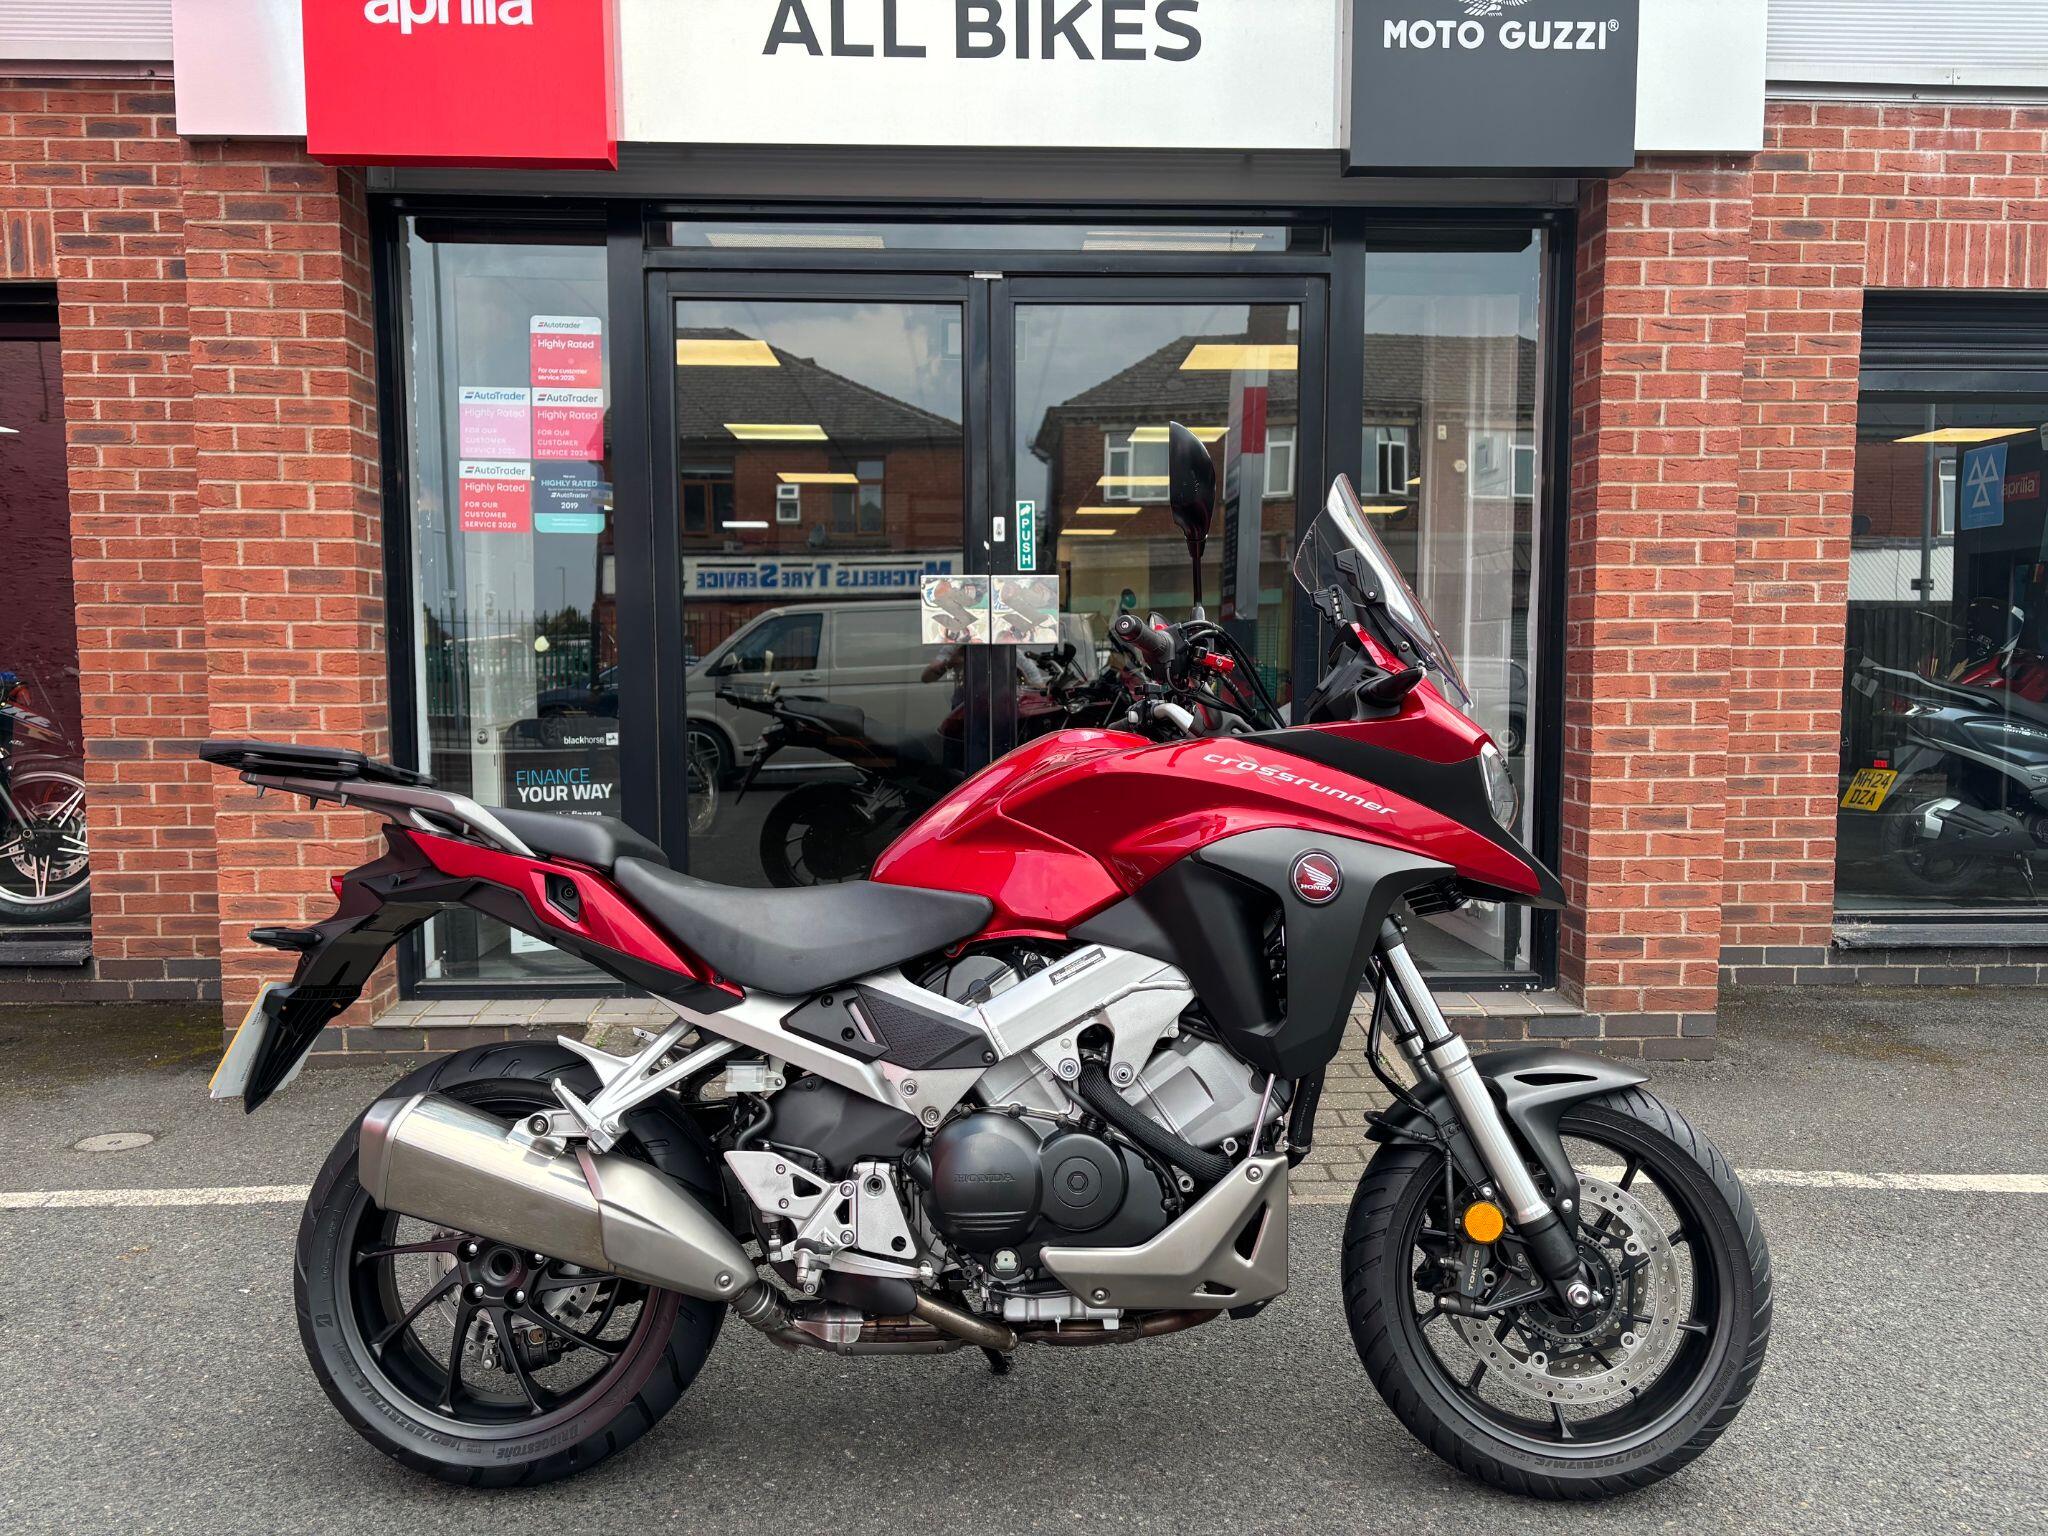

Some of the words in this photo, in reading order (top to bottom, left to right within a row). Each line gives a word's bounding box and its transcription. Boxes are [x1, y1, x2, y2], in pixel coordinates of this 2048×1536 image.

[762, 0, 927, 58] ALL
[956, 0, 1202, 62] BIKES
[1383, 19, 1485, 50] MOTO
[537, 339, 566, 350] Highly
[567, 340, 594, 349] Rated
[474, 391, 525, 401] AutoTrader
[547, 394, 598, 403] AutoTrader
[465, 408, 495, 419] Highly
[496, 408, 525, 418] Rated
[537, 410, 567, 421] Highly
[569, 411, 598, 420] Rated
[537, 439, 578, 447] CUSTOMER
[474, 466, 526, 476] AutoTrader
[464, 482, 495, 494] Highly
[497, 483, 525, 493] Rated
[540, 479, 571, 487] HIGHLY
[571, 480, 598, 488] RATED
[2001, 476, 2035, 498] aprilia
[561, 501, 579, 510] 2019
[464, 511, 507, 519] CUSTOMER
[464, 520, 496, 528] SERVICE
[498, 521, 517, 529] 2020
[1021, 518, 1032, 565] PUSH
[563, 735, 605, 745] blackhorse
[515, 767, 590, 786] FINANCE
[1852, 771, 1893, 789] MH24
[1202, 753, 1398, 816] crossrunner
[517, 785, 569, 804] YOUR
[571, 783, 613, 801] WAY
[1848, 788, 1877, 806] DZA
[1300, 883, 1332, 892] HONDA
[952, 1172, 1016, 1184] HONDA
[1467, 1249, 1480, 1292] TOKICO
